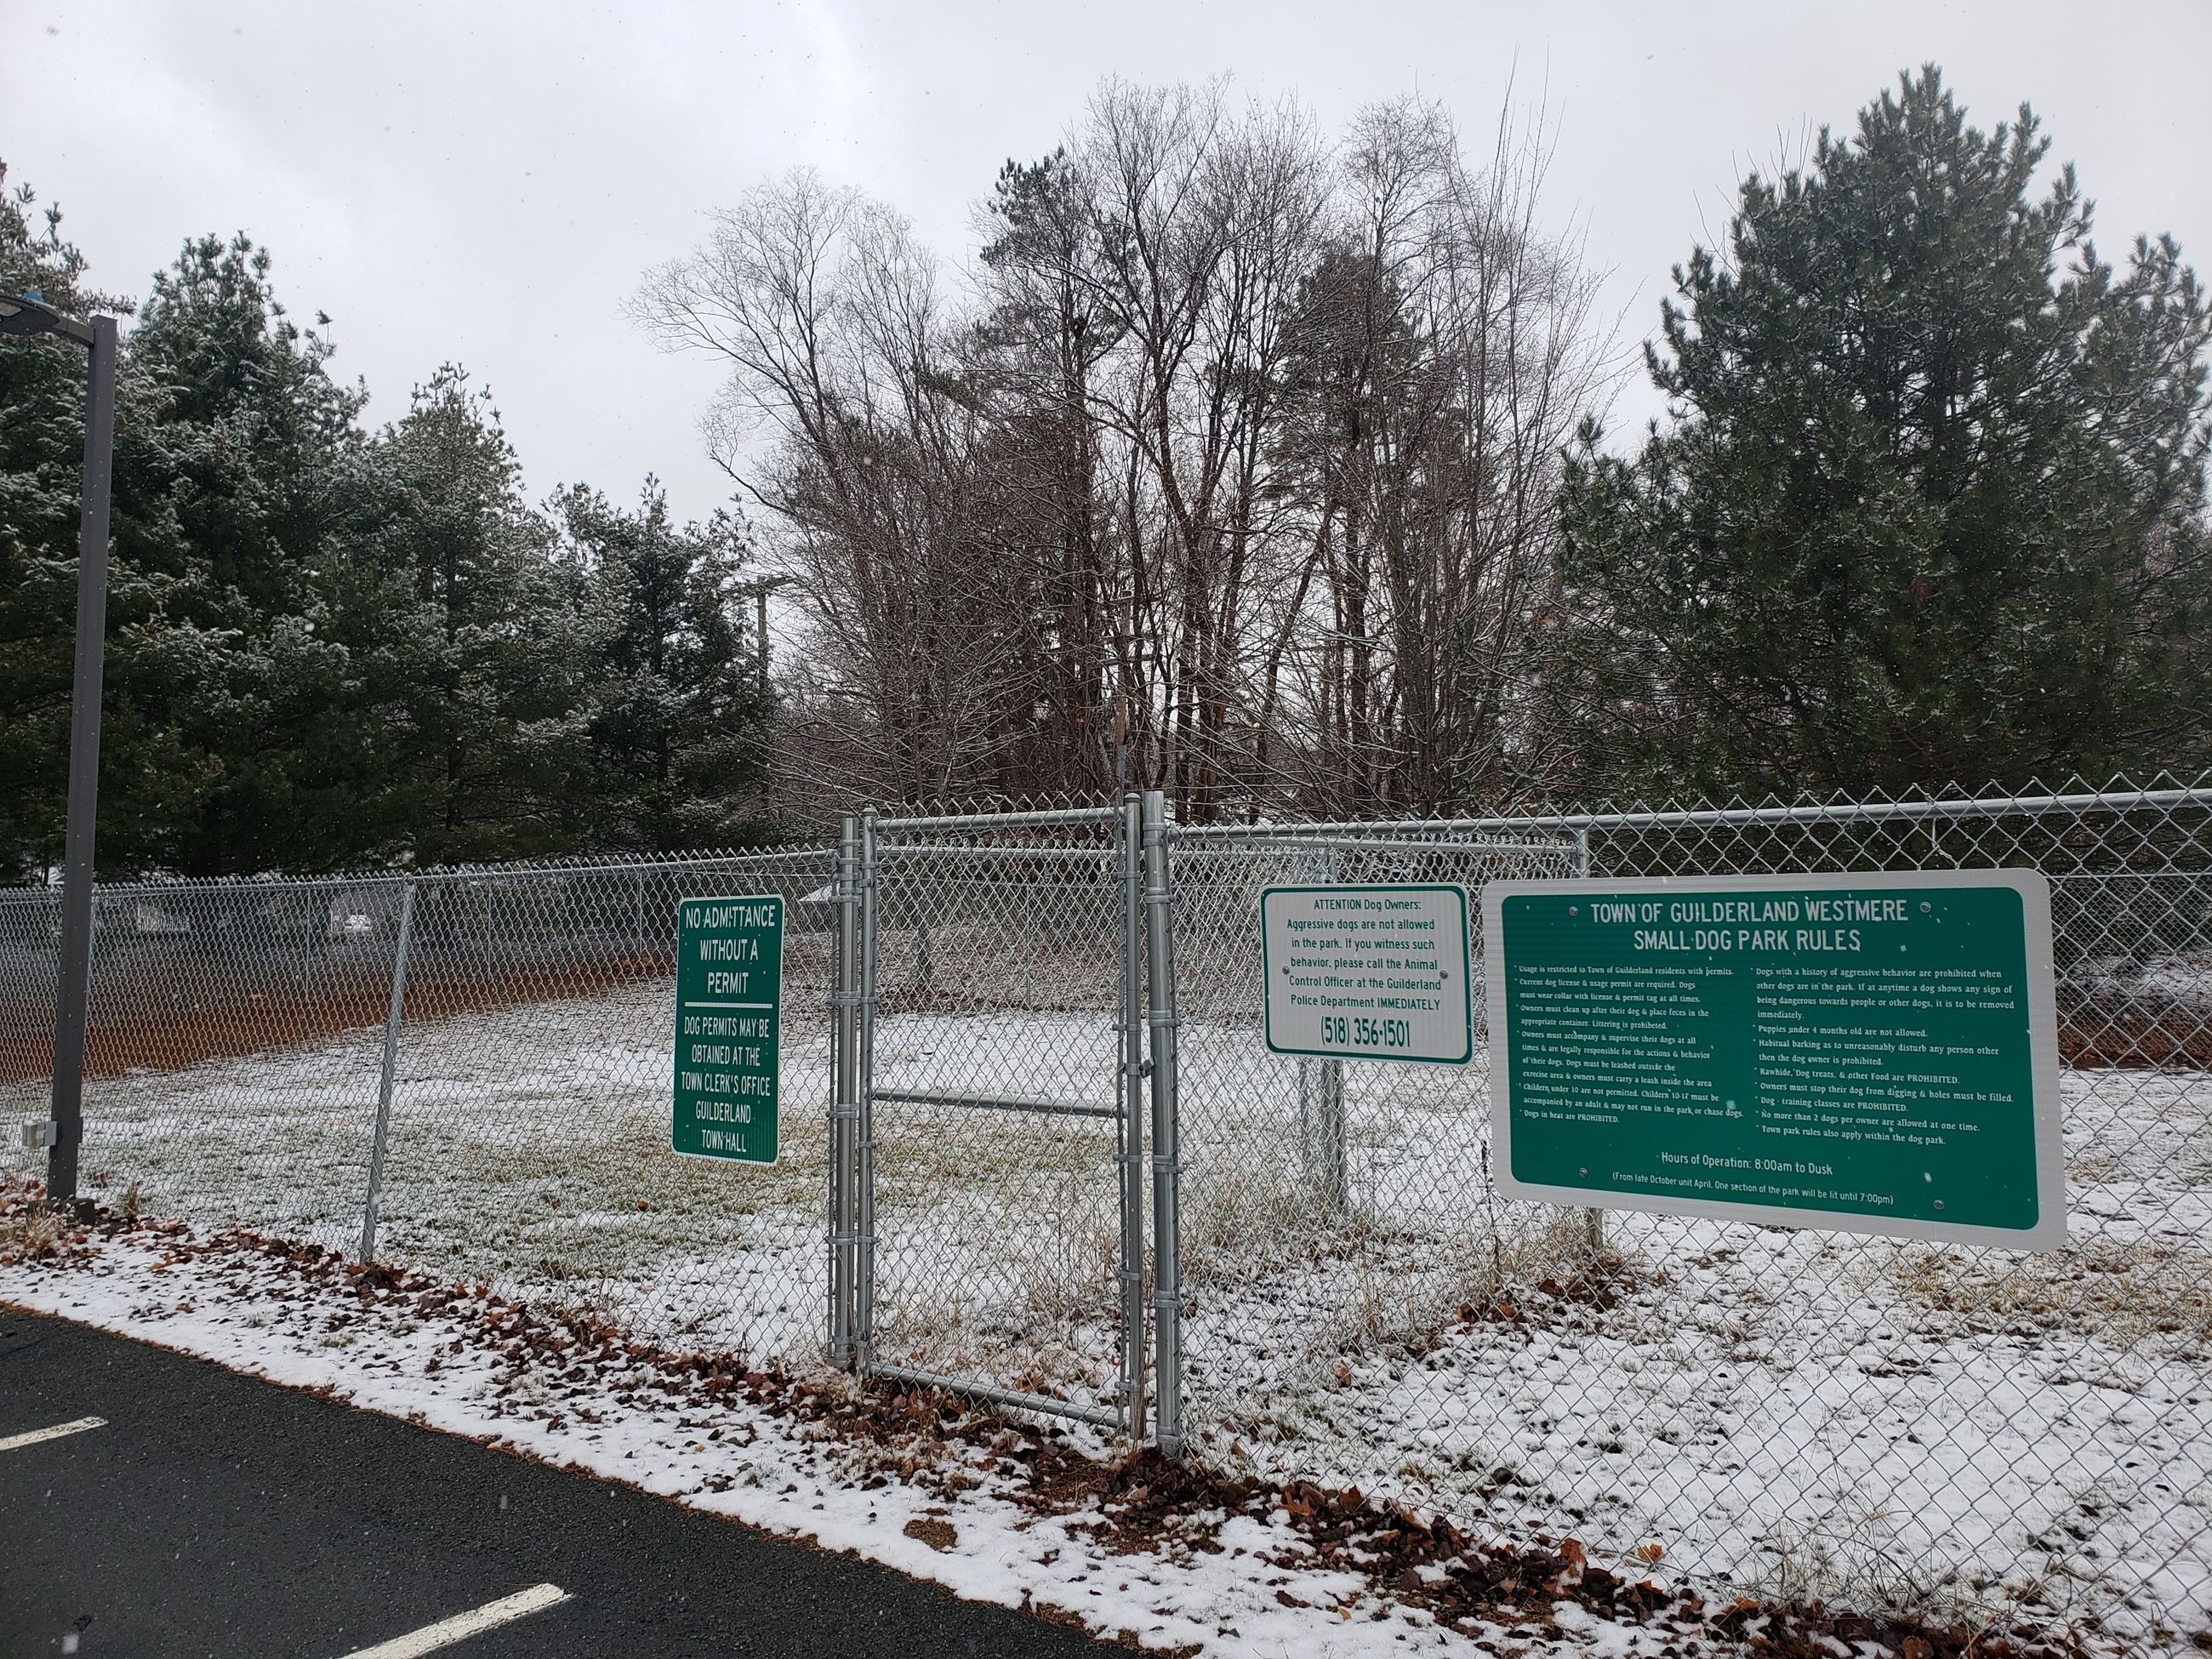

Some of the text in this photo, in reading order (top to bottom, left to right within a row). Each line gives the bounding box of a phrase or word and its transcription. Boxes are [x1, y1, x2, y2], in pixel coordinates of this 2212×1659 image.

[1314, 898, 1421, 912] ATTENTION Dog Owners:
[1590, 899, 1908, 922] TOWN OF GUILDERLAND WESTMERE
[686, 905, 774, 928] NO ADMITTANCE
[1286, 919, 1434, 932] Aggressive dogs are not allowed
[1291, 937, 1434, 951] in the park. If you witness such
[1633, 929, 1861, 950] SMALL DOG PARK RULES
[700, 938, 758, 960] WITHOUT A
[1334, 957, 1363, 970] please
[1366, 958, 1382, 968] call
[1386, 958, 1401, 968] the
[1404, 958, 1437, 969] Animal
[1705, 966, 1734, 976] permits.
[1756, 967, 1773, 977] Dogs
[1776, 967, 1792, 978] with
[1802, 967, 1827, 977] history
[1829, 967, 1838, 978] of
[1839, 969, 1879, 978] aggressive
[1934, 969, 1976, 978] prohibited
[707, 972, 748, 993] PERMIT
[1289, 975, 1441, 989] Control Officer at the Guilderland
[1544, 978, 1557, 987] dog
[1679, 981, 1696, 989] Dogs
[1291, 994, 1440, 1010] Police Department IMMEDIATELY
[1757, 1011, 1804, 1019] immediately.
[684, 1016, 769, 1037] DOG PERMITS MAY BE
[1320, 1017, 1410, 1046] (518) 356-1501
[1592, 1020, 1620, 1029] Littering
[1622, 1020, 1628, 1029] is
[1758, 1025, 1786, 1034] Puppies
[1864, 1029, 1877, 1037] are
[692, 1044, 760, 1066] OBTAINED AT THE
[1792, 1040, 1821, 1050] barking
[1844, 1043, 1896, 1052] unreasonably
[1897, 1043, 1926, 1052] disturb
[1929, 1046, 1944, 1054] any
[1792, 1054, 1805, 1063] dog
[1842, 1057, 1883, 1065] prohibited.
[681, 1071, 770, 1096] TOWN CLERK'S OFFICE
[695, 1101, 750, 1122] GUILDERLAND
[1524, 1109, 1539, 1118] Dogs
[1577, 1114, 1619, 1122] PROHIBITED.
[702, 1129, 746, 1152] TOWN HALL
[1783, 1126, 1800, 1135] park
[1841, 1131, 1861, 1140] apply
[1864, 1132, 1890, 1140] within
[1907, 1134, 1923, 1144] dog
[1925, 1136, 1946, 1144] park.
[1662, 1151, 1833, 1174] Hours of Operation: 8:00am to Dusk
[1612, 1172, 1633, 1180] (From
[1634, 1173, 1648, 1183] late
[1650, 1175, 1677, 1184] October
[1714, 1180, 1729, 1189] One
[1768, 1185, 1780, 1194] the
[1782, 1188, 1799, 1196] park
[1817, 1189, 1827, 1198] be
[1829, 1190, 1838, 1199] lit
[1839, 1192, 1857, 1200] until
[1860, 1193, 1893, 1205] 7:00pm)
